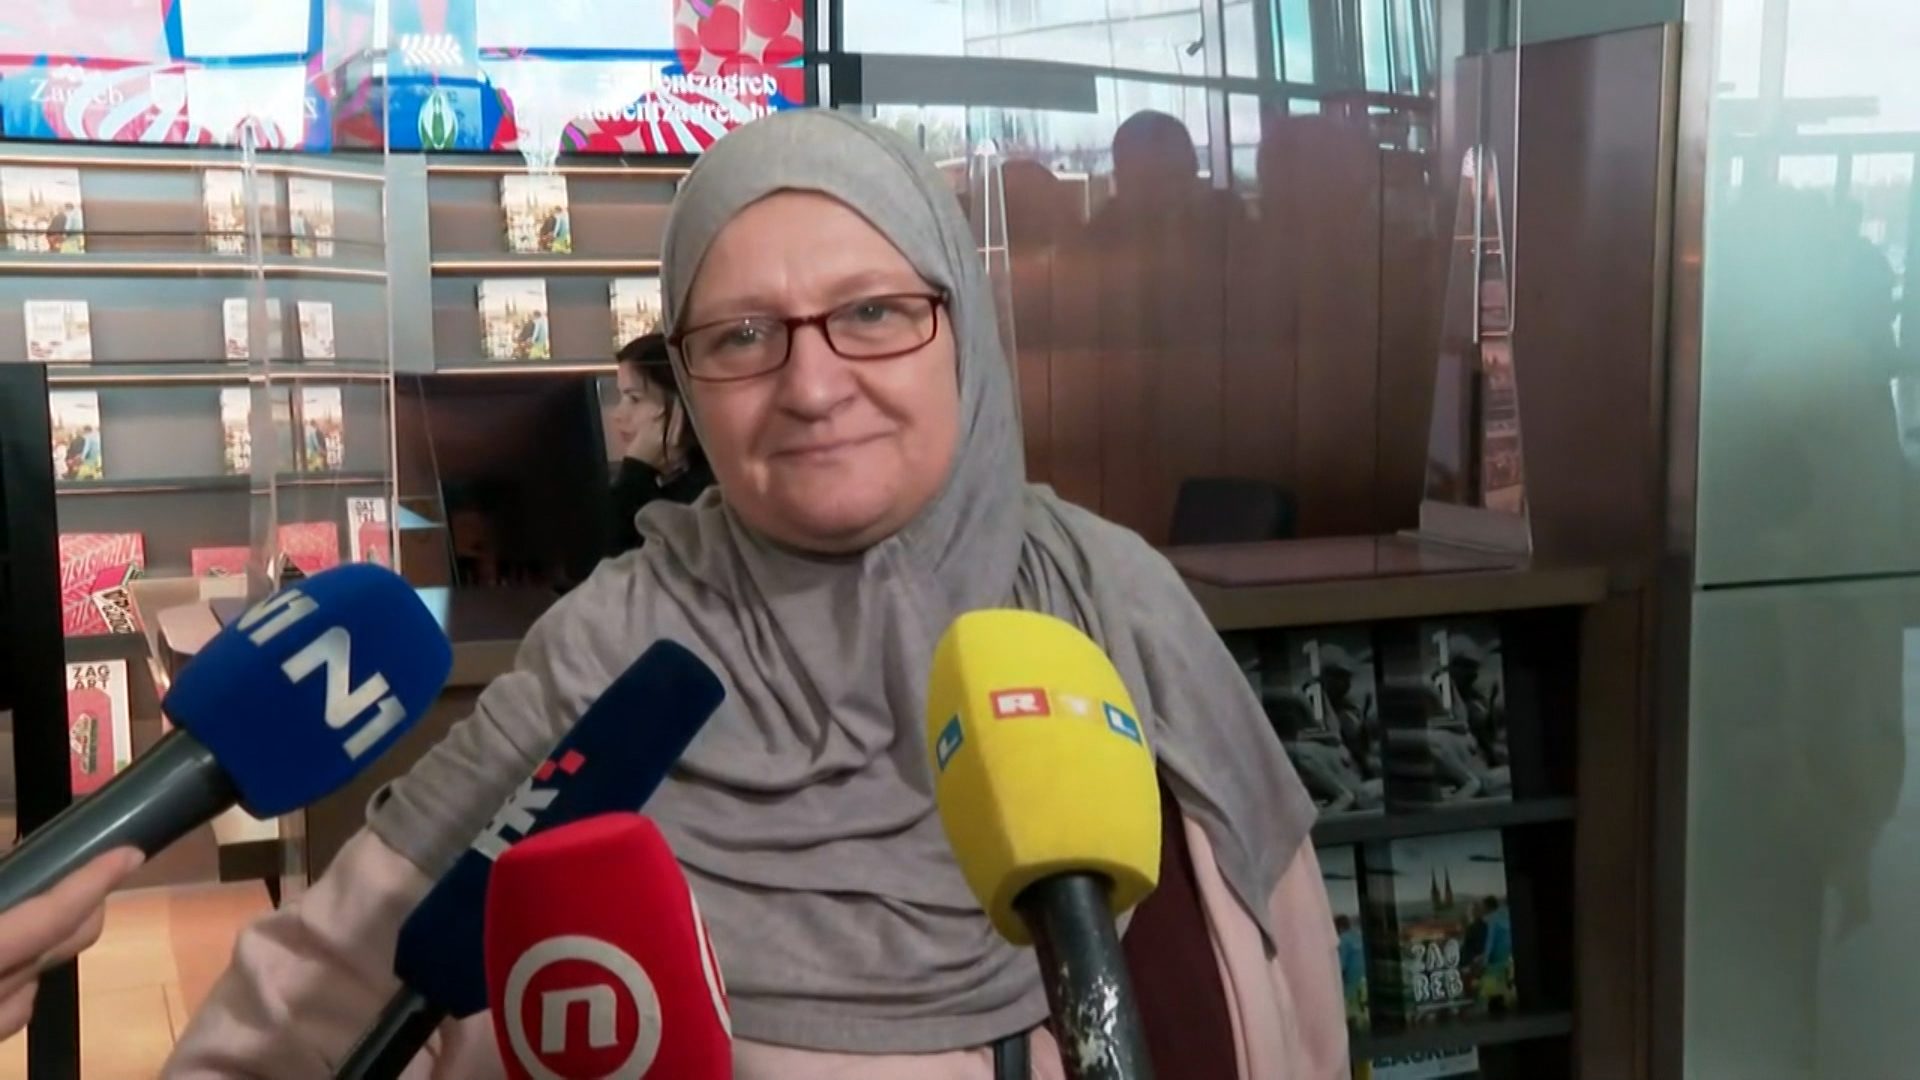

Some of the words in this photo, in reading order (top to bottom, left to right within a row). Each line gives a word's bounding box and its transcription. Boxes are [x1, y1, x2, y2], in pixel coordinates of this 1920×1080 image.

[30, 78, 124, 107] Zaeb
[72, 664, 110, 680] ZAG
[281, 625, 407, 761] N1
